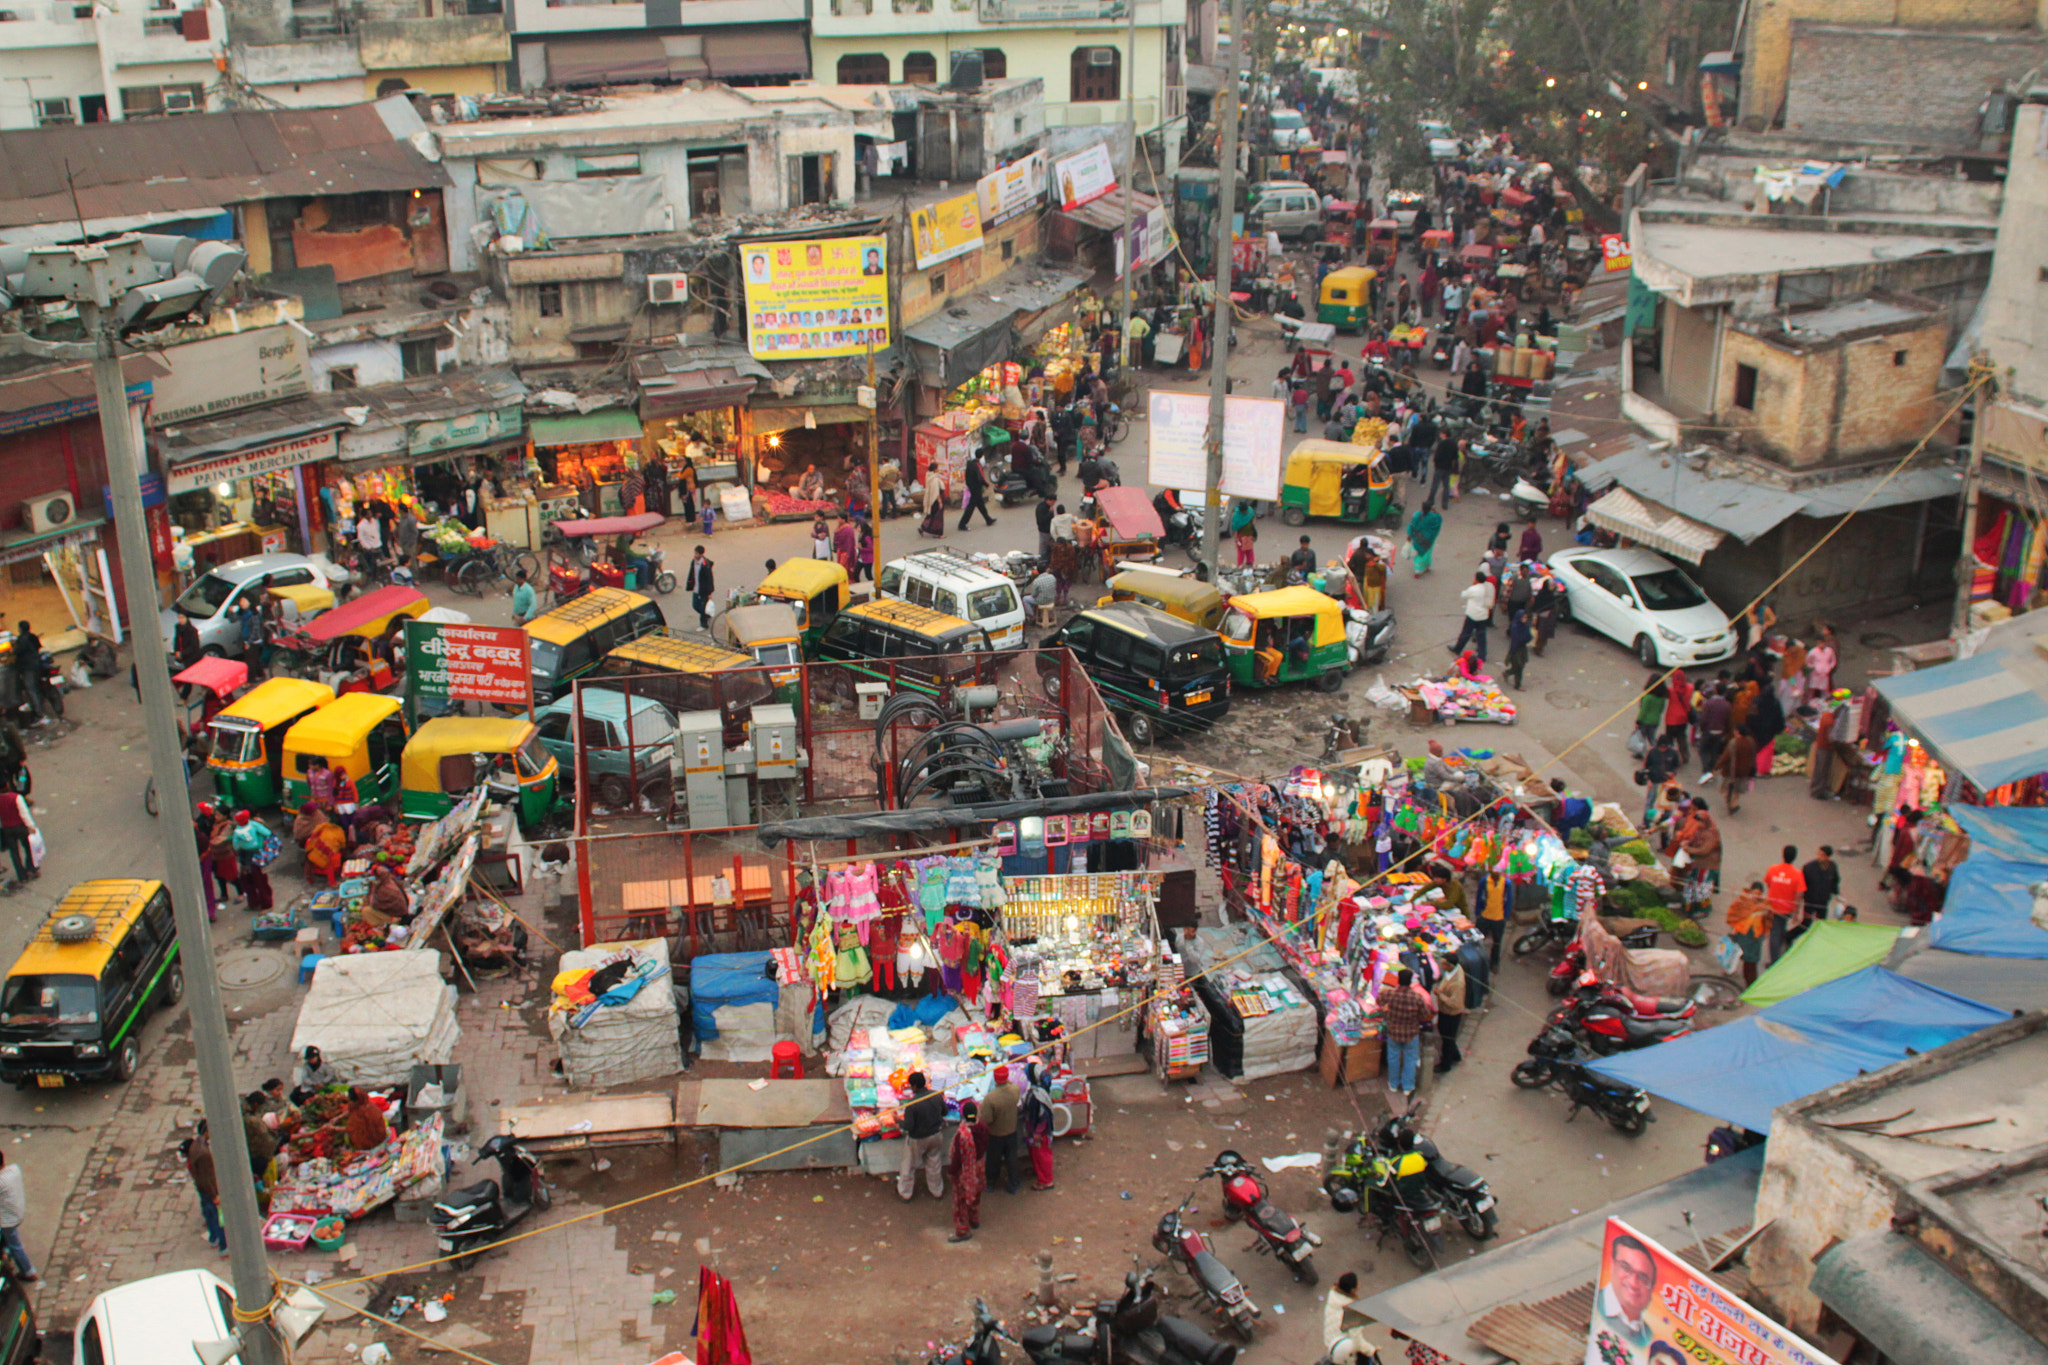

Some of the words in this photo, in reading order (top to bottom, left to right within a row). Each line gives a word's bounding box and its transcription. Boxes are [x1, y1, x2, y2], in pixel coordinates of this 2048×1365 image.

[258, 341, 297, 361] Berger
[152, 404, 208, 423] KRISHNA
[207, 388, 268, 412] BROTHERS
[193, 465, 247, 487] PAINTS
[436, 628, 498, 641] कार्यालय
[1709, 1289, 1746, 1326] दिल्ली
[1660, 1284, 1699, 1327] श्री
[1699, 1308, 1774, 1365] अजय
